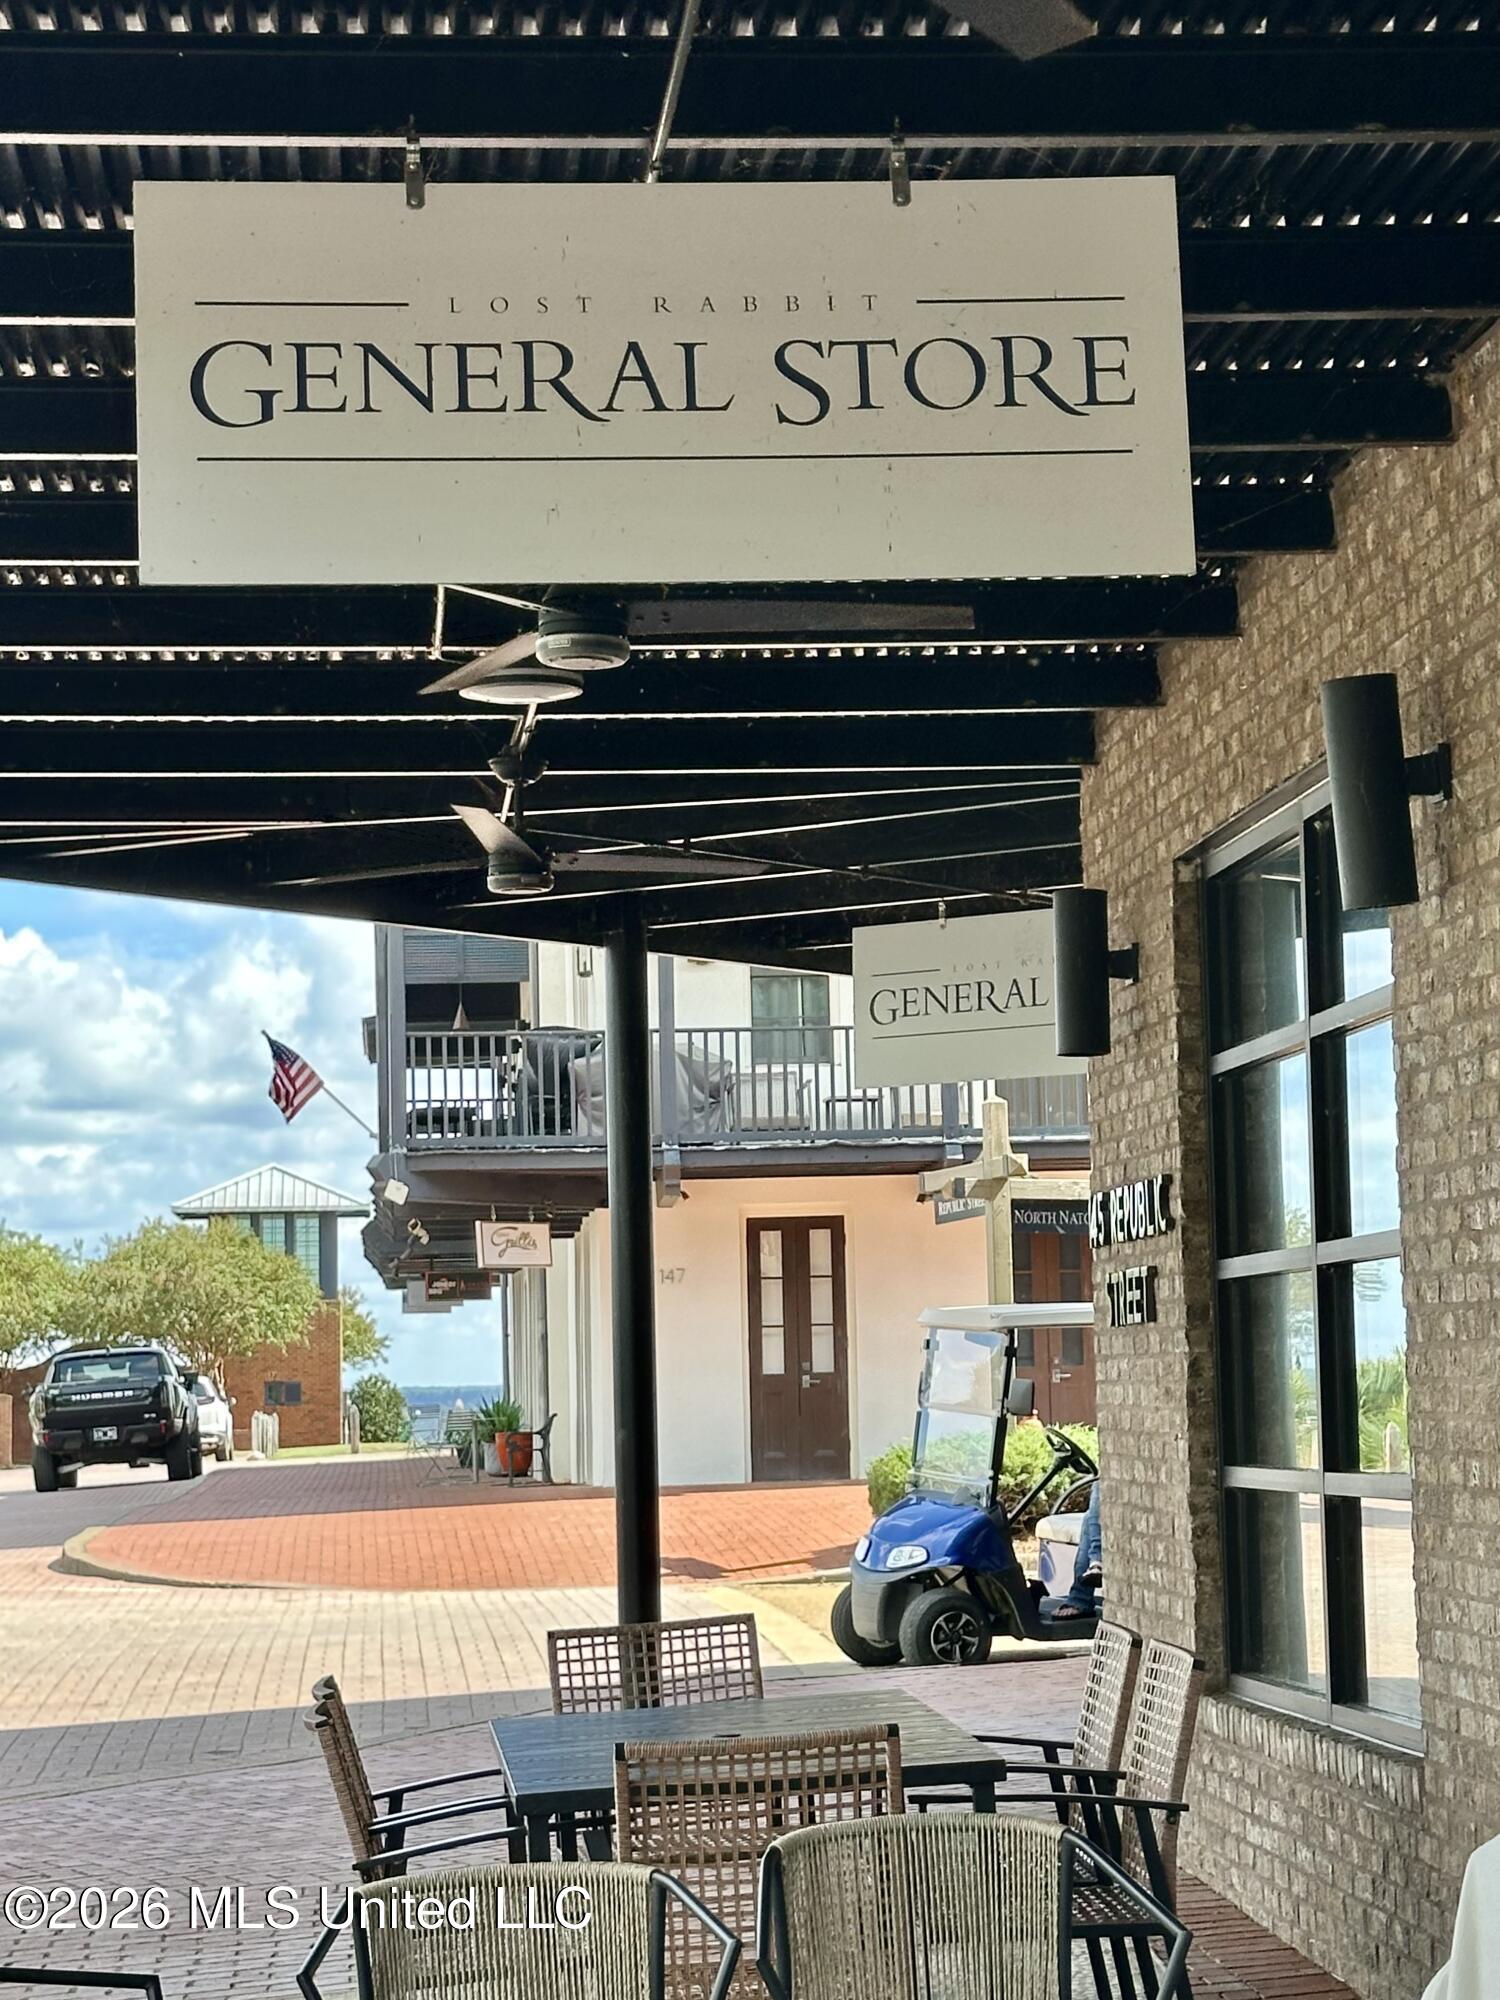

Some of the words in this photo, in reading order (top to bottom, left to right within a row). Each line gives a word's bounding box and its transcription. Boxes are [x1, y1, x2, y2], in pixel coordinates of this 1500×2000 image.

[449, 295, 592, 314] LOST
[653, 294, 880, 313] RABBIT
[189, 340, 735, 428] GENERAL
[773, 334, 1136, 426] STORE
[953, 960, 1002, 973] LOST
[869, 976, 1049, 1026] GENERAL
[1014, 1208, 1056, 1225] NORTH
[1110, 1173, 1166, 1244] REPUBLIC
[659, 1267, 686, 1284] 147
